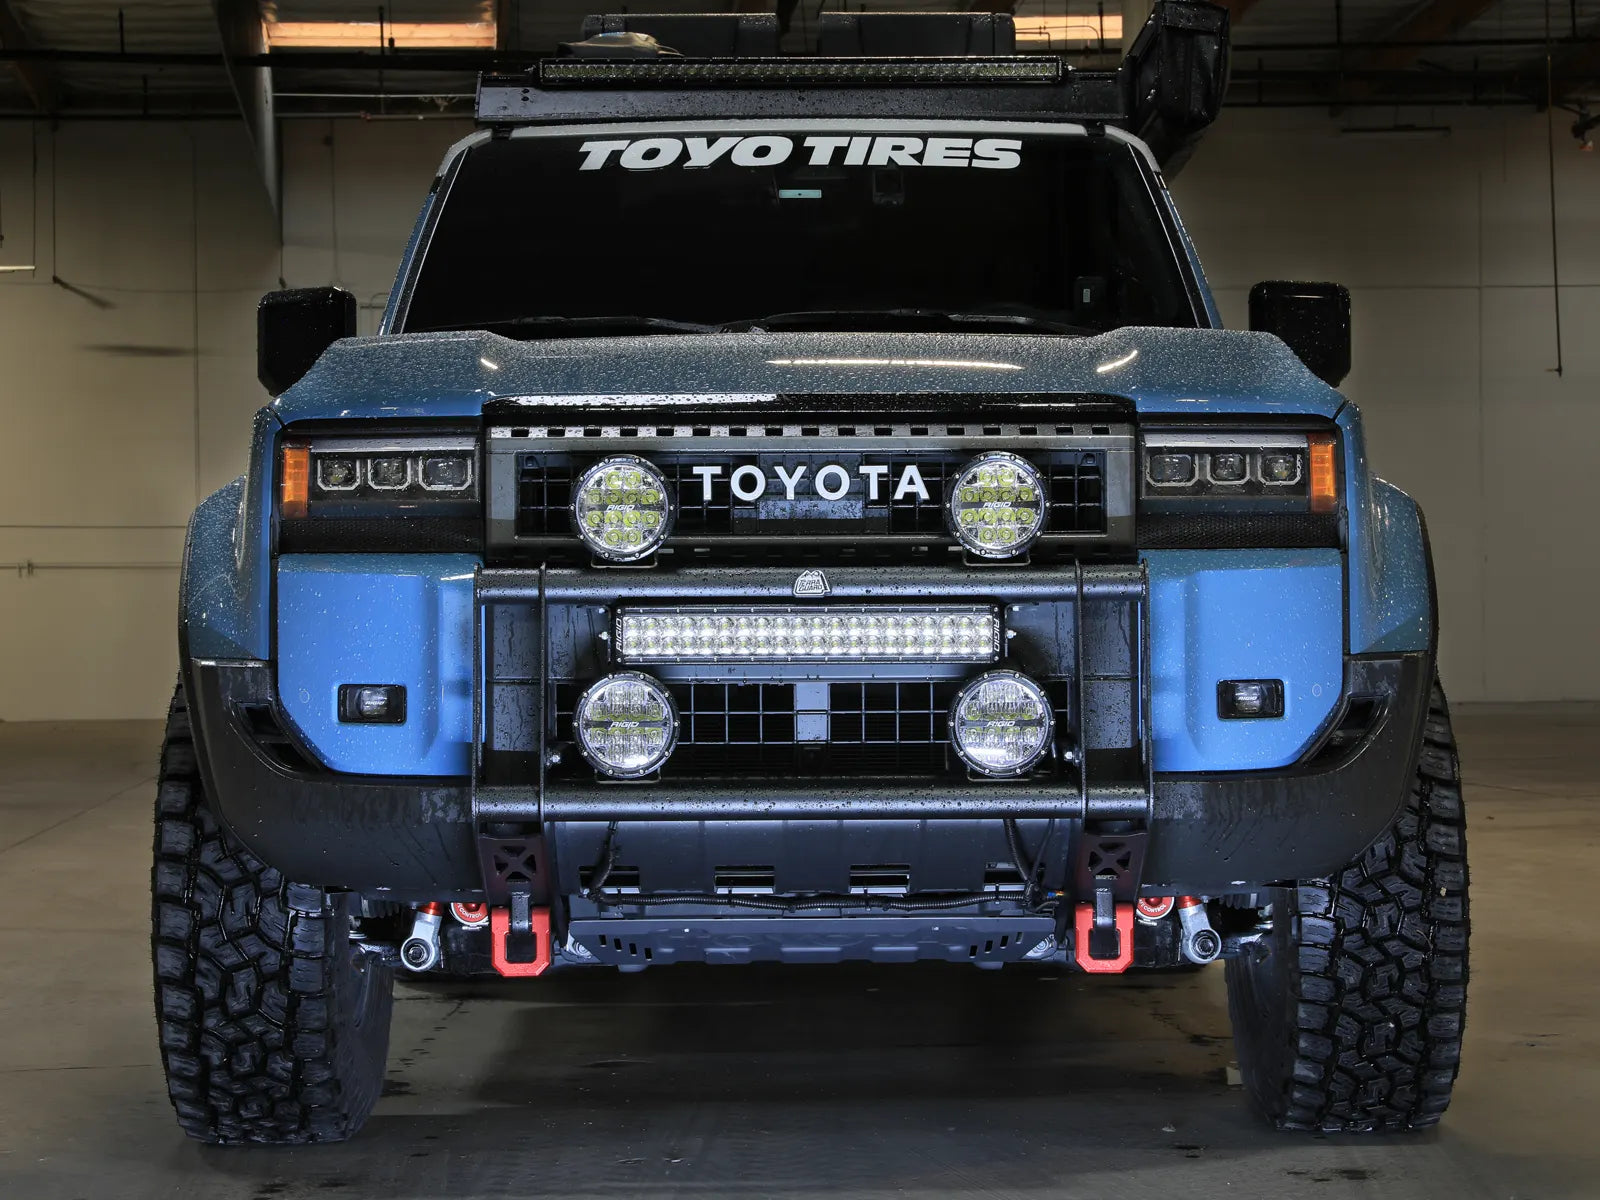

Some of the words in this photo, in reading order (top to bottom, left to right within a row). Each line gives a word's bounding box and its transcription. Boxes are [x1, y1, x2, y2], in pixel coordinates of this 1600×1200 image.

[578, 135, 794, 171] TOYO
[802, 135, 1023, 170] TIRES
[692, 464, 931, 501] TOYOTA
[608, 721, 640, 729] RIGID
